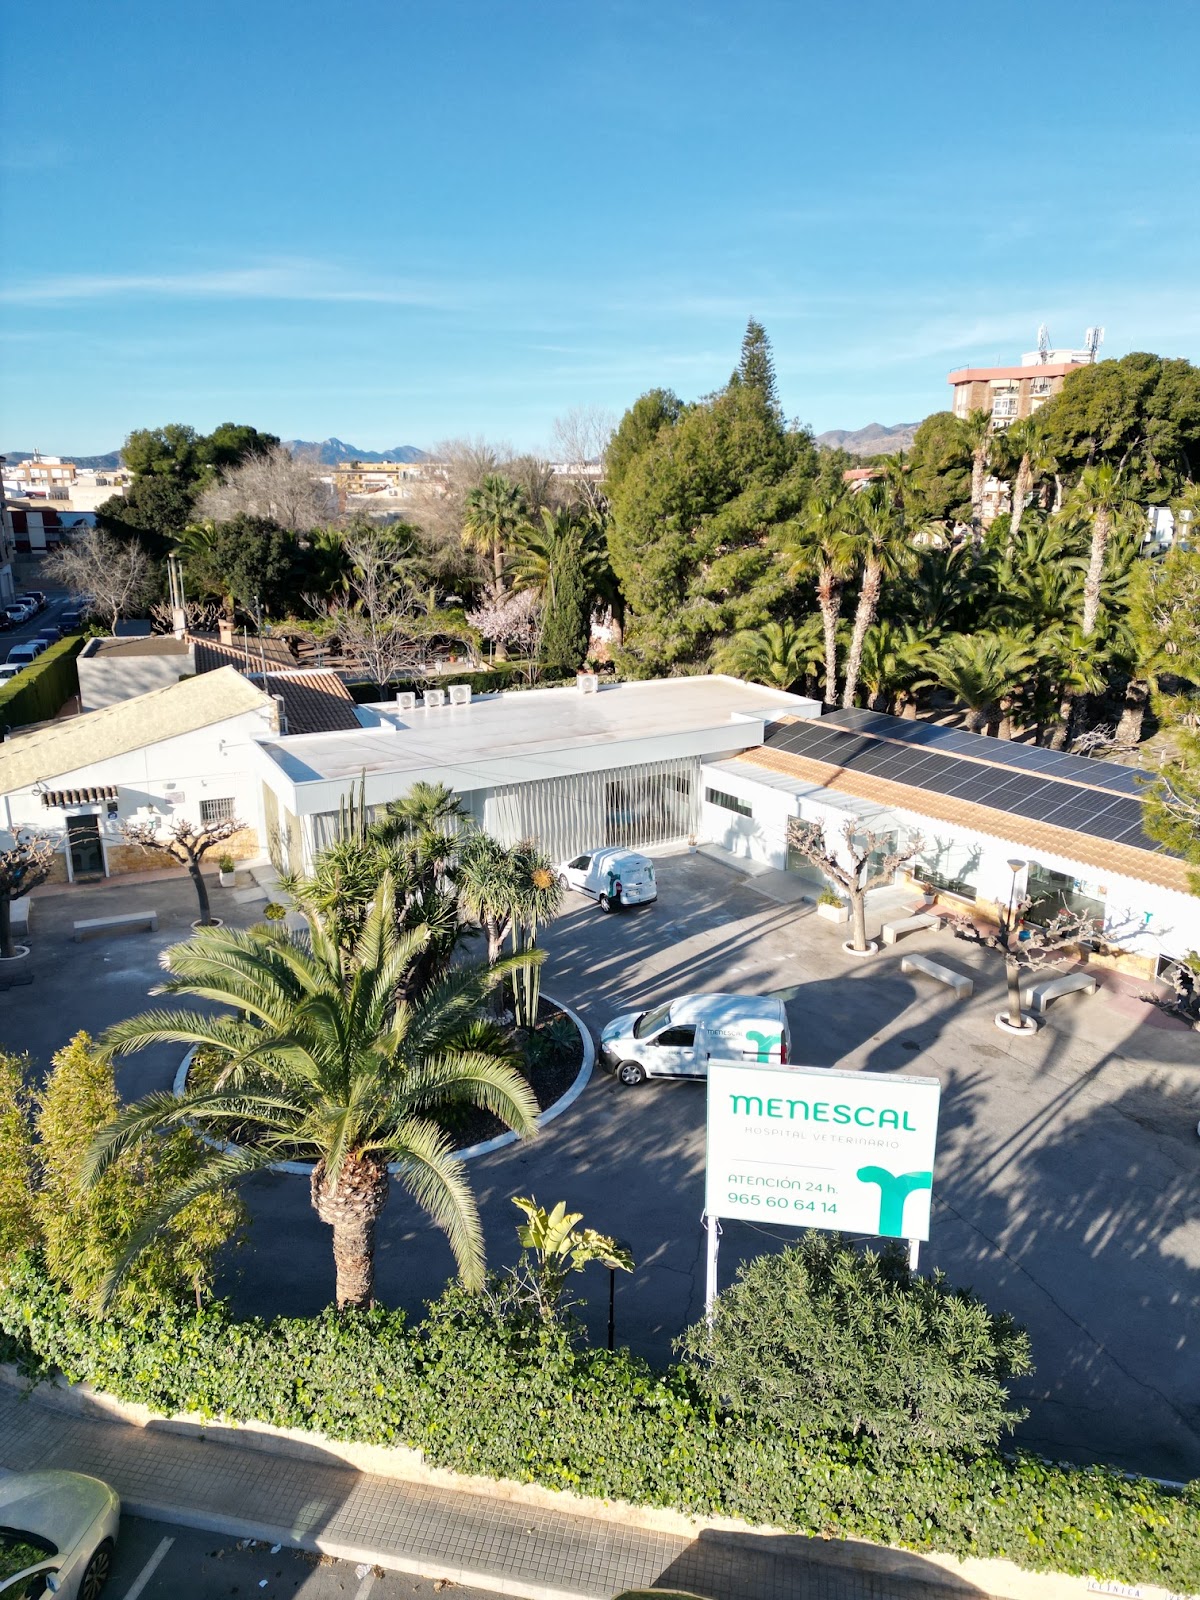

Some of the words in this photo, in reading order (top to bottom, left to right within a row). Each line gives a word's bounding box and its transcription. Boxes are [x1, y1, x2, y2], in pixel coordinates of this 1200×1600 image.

[729, 1094, 917, 1132] MENESCAL
[744, 1126, 807, 1140] HOSPITAL
[813, 1133, 900, 1149] VETERINARIO
[728, 1174, 801, 1190] ATENCIÓN
[728, 1192, 761, 1206] 965
[766, 1196, 789, 1209] 60
[794, 1199, 815, 1212] 64
[821, 1202, 838, 1214] 14
